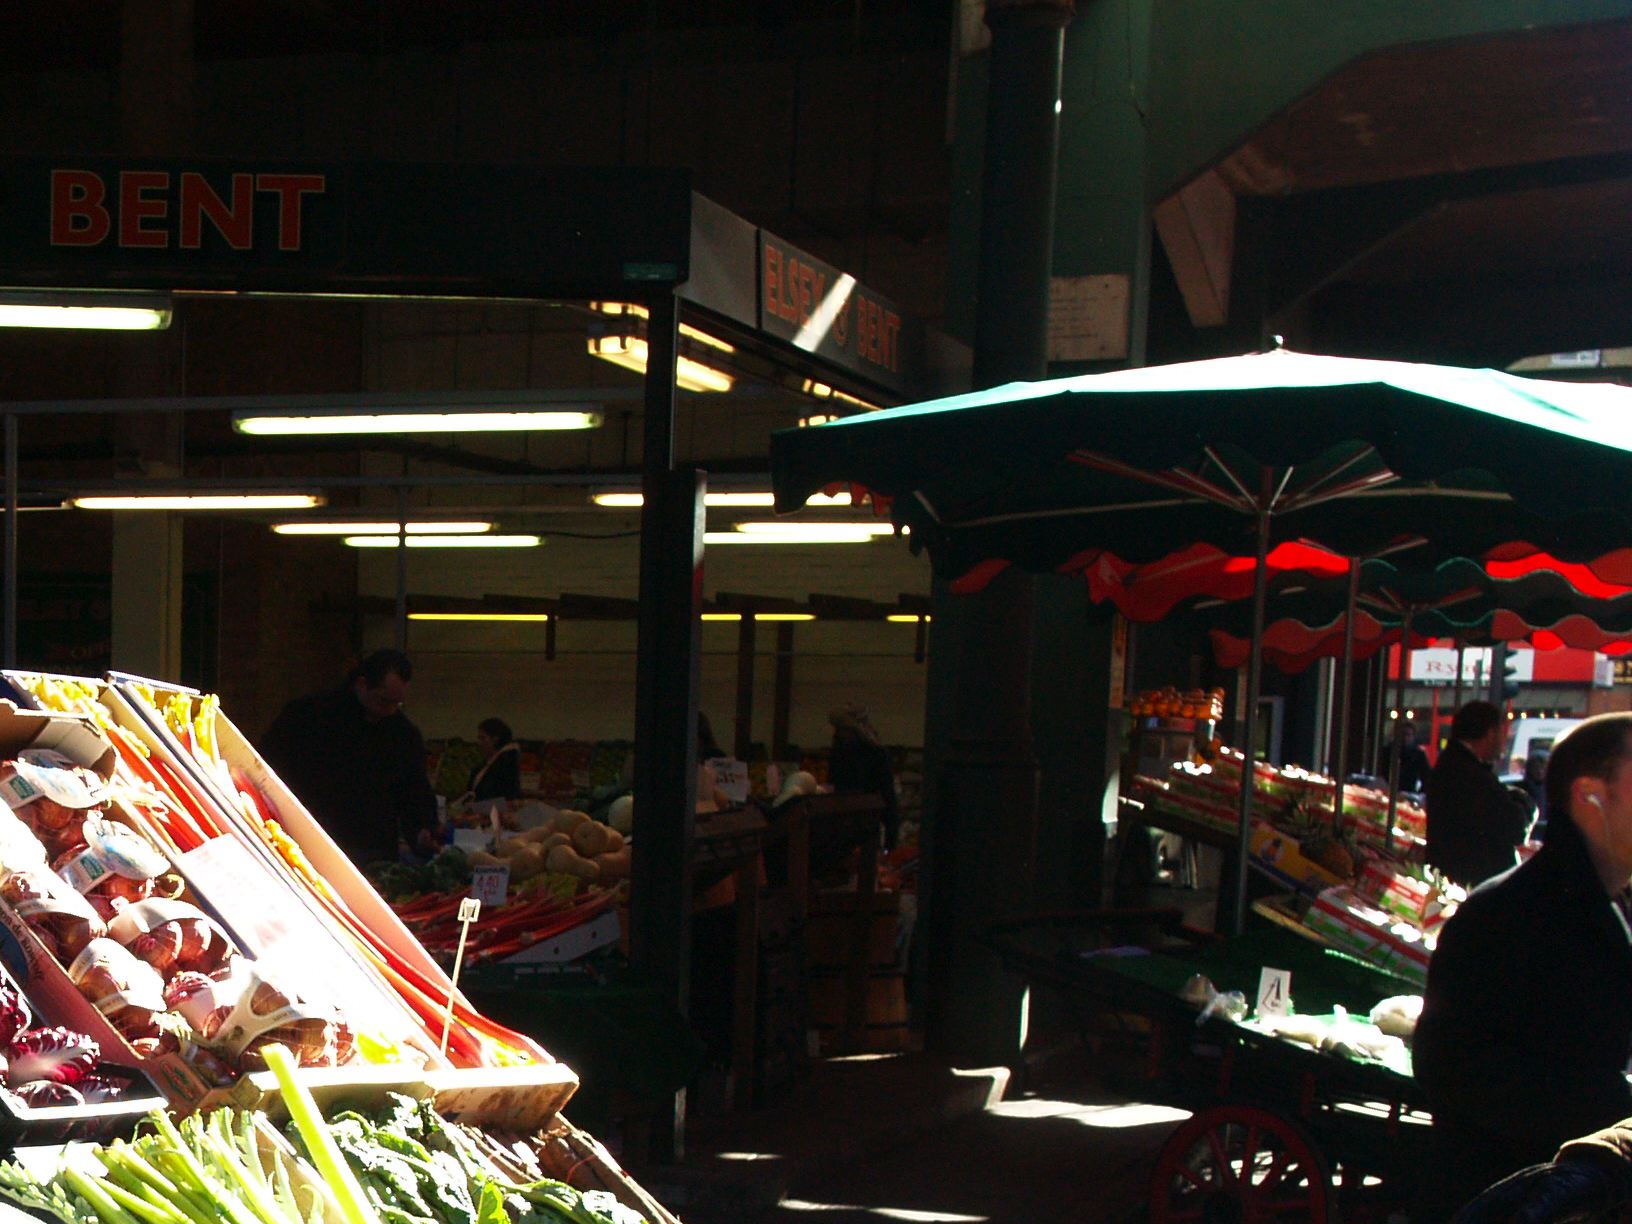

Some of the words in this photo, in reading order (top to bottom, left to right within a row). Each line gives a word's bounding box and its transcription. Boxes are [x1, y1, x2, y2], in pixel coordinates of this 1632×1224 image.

[49, 168, 327, 252] BENT
[765, 244, 826, 326] ELSEY
[857, 294, 901, 374] BENT
